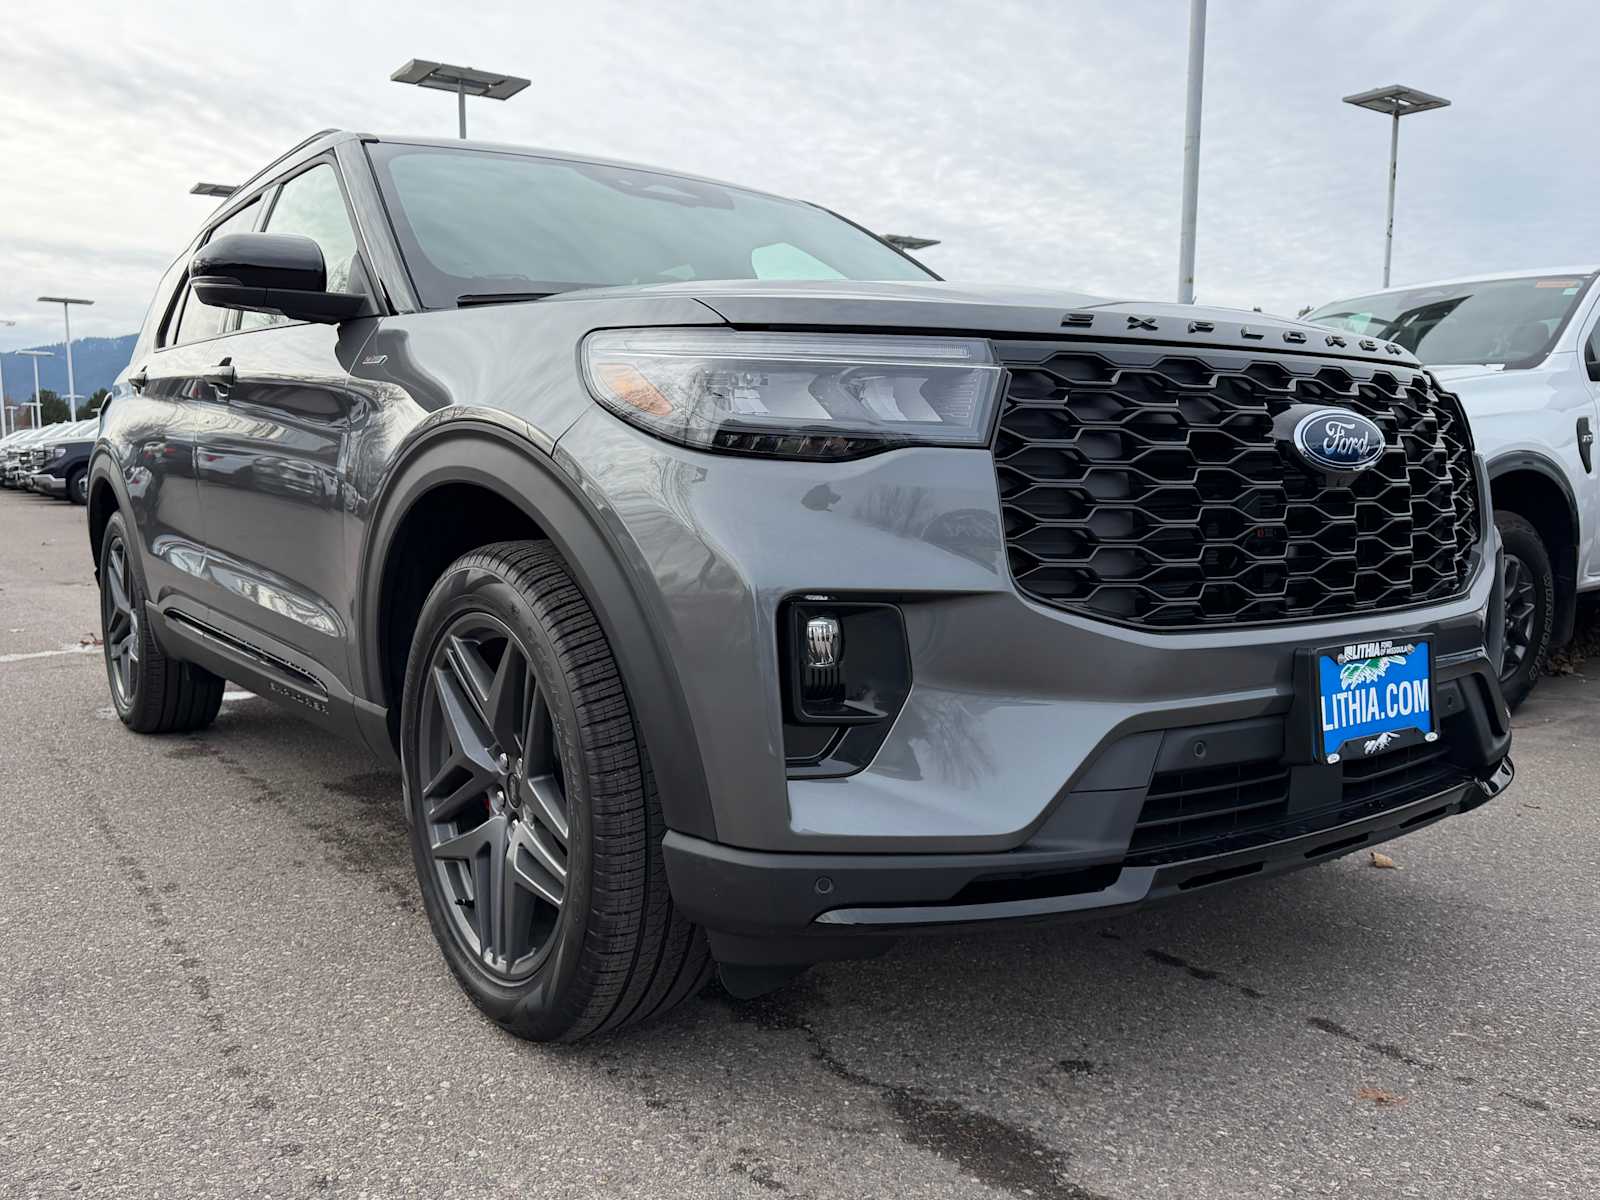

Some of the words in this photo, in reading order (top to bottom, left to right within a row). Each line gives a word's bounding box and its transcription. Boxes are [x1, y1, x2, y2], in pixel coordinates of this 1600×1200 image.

[1060, 312, 1403, 356] EXPLORER
[1323, 421, 1370, 455] Ford
[1352, 642, 1380, 660] LITHIA
[1320, 678, 1430, 732] LITHIA.COM
